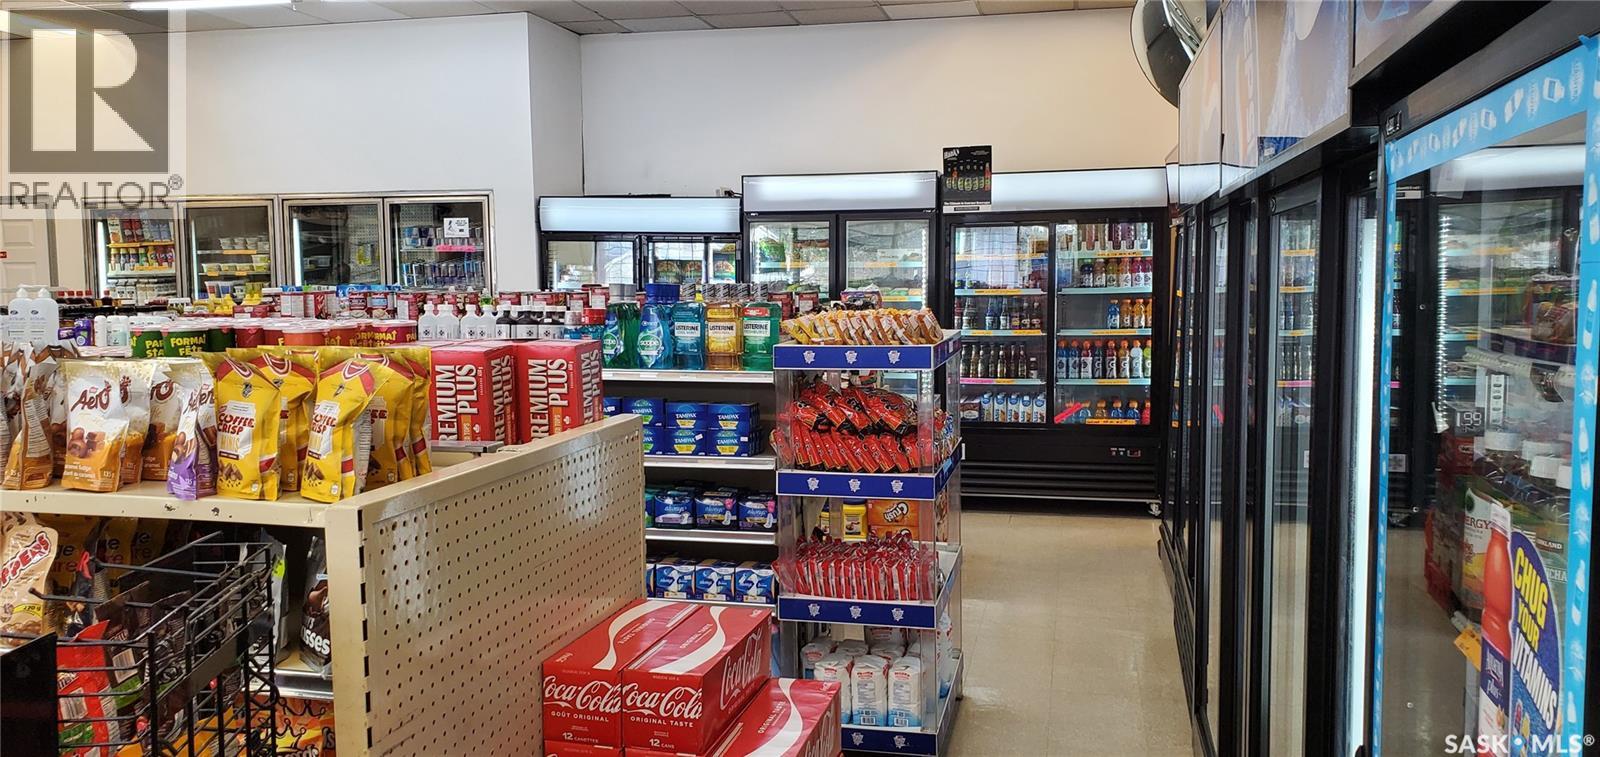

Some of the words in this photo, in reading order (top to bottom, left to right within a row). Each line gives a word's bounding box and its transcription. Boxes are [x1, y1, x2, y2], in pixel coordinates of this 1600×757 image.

[170, 336, 206, 348] FORMAT
[456, 364, 478, 414] PLUS
[501, 355, 513, 404] PLUS
[547, 358, 568, 406] PLUS
[581, 352, 594, 424] REMIUM
[589, 349, 600, 396] PLUS
[218, 412, 255, 428] COFFEE
[435, 365, 458, 441] REMIUM
[491, 358, 506, 441] REMIUM
[528, 359, 549, 438] REMIUM
[217, 423, 244, 435] CRISP
[883, 502, 909, 523] Crush
[1465, 516, 1492, 530] ERGY
[0, 532, 50, 586] PPERS
[1514, 547, 1548, 629] CHUG
[1518, 597, 1540, 653] YOUR
[1512, 627, 1557, 730] VITAMINS
[551, 710, 570, 718] GOÛT
[573, 713, 609, 723] ORIGINAL
[562, 732, 574, 740] 12
[630, 716, 667, 726] ORIGINAL
[670, 720, 694, 728] TASTE
[649, 738, 661, 747] 12
